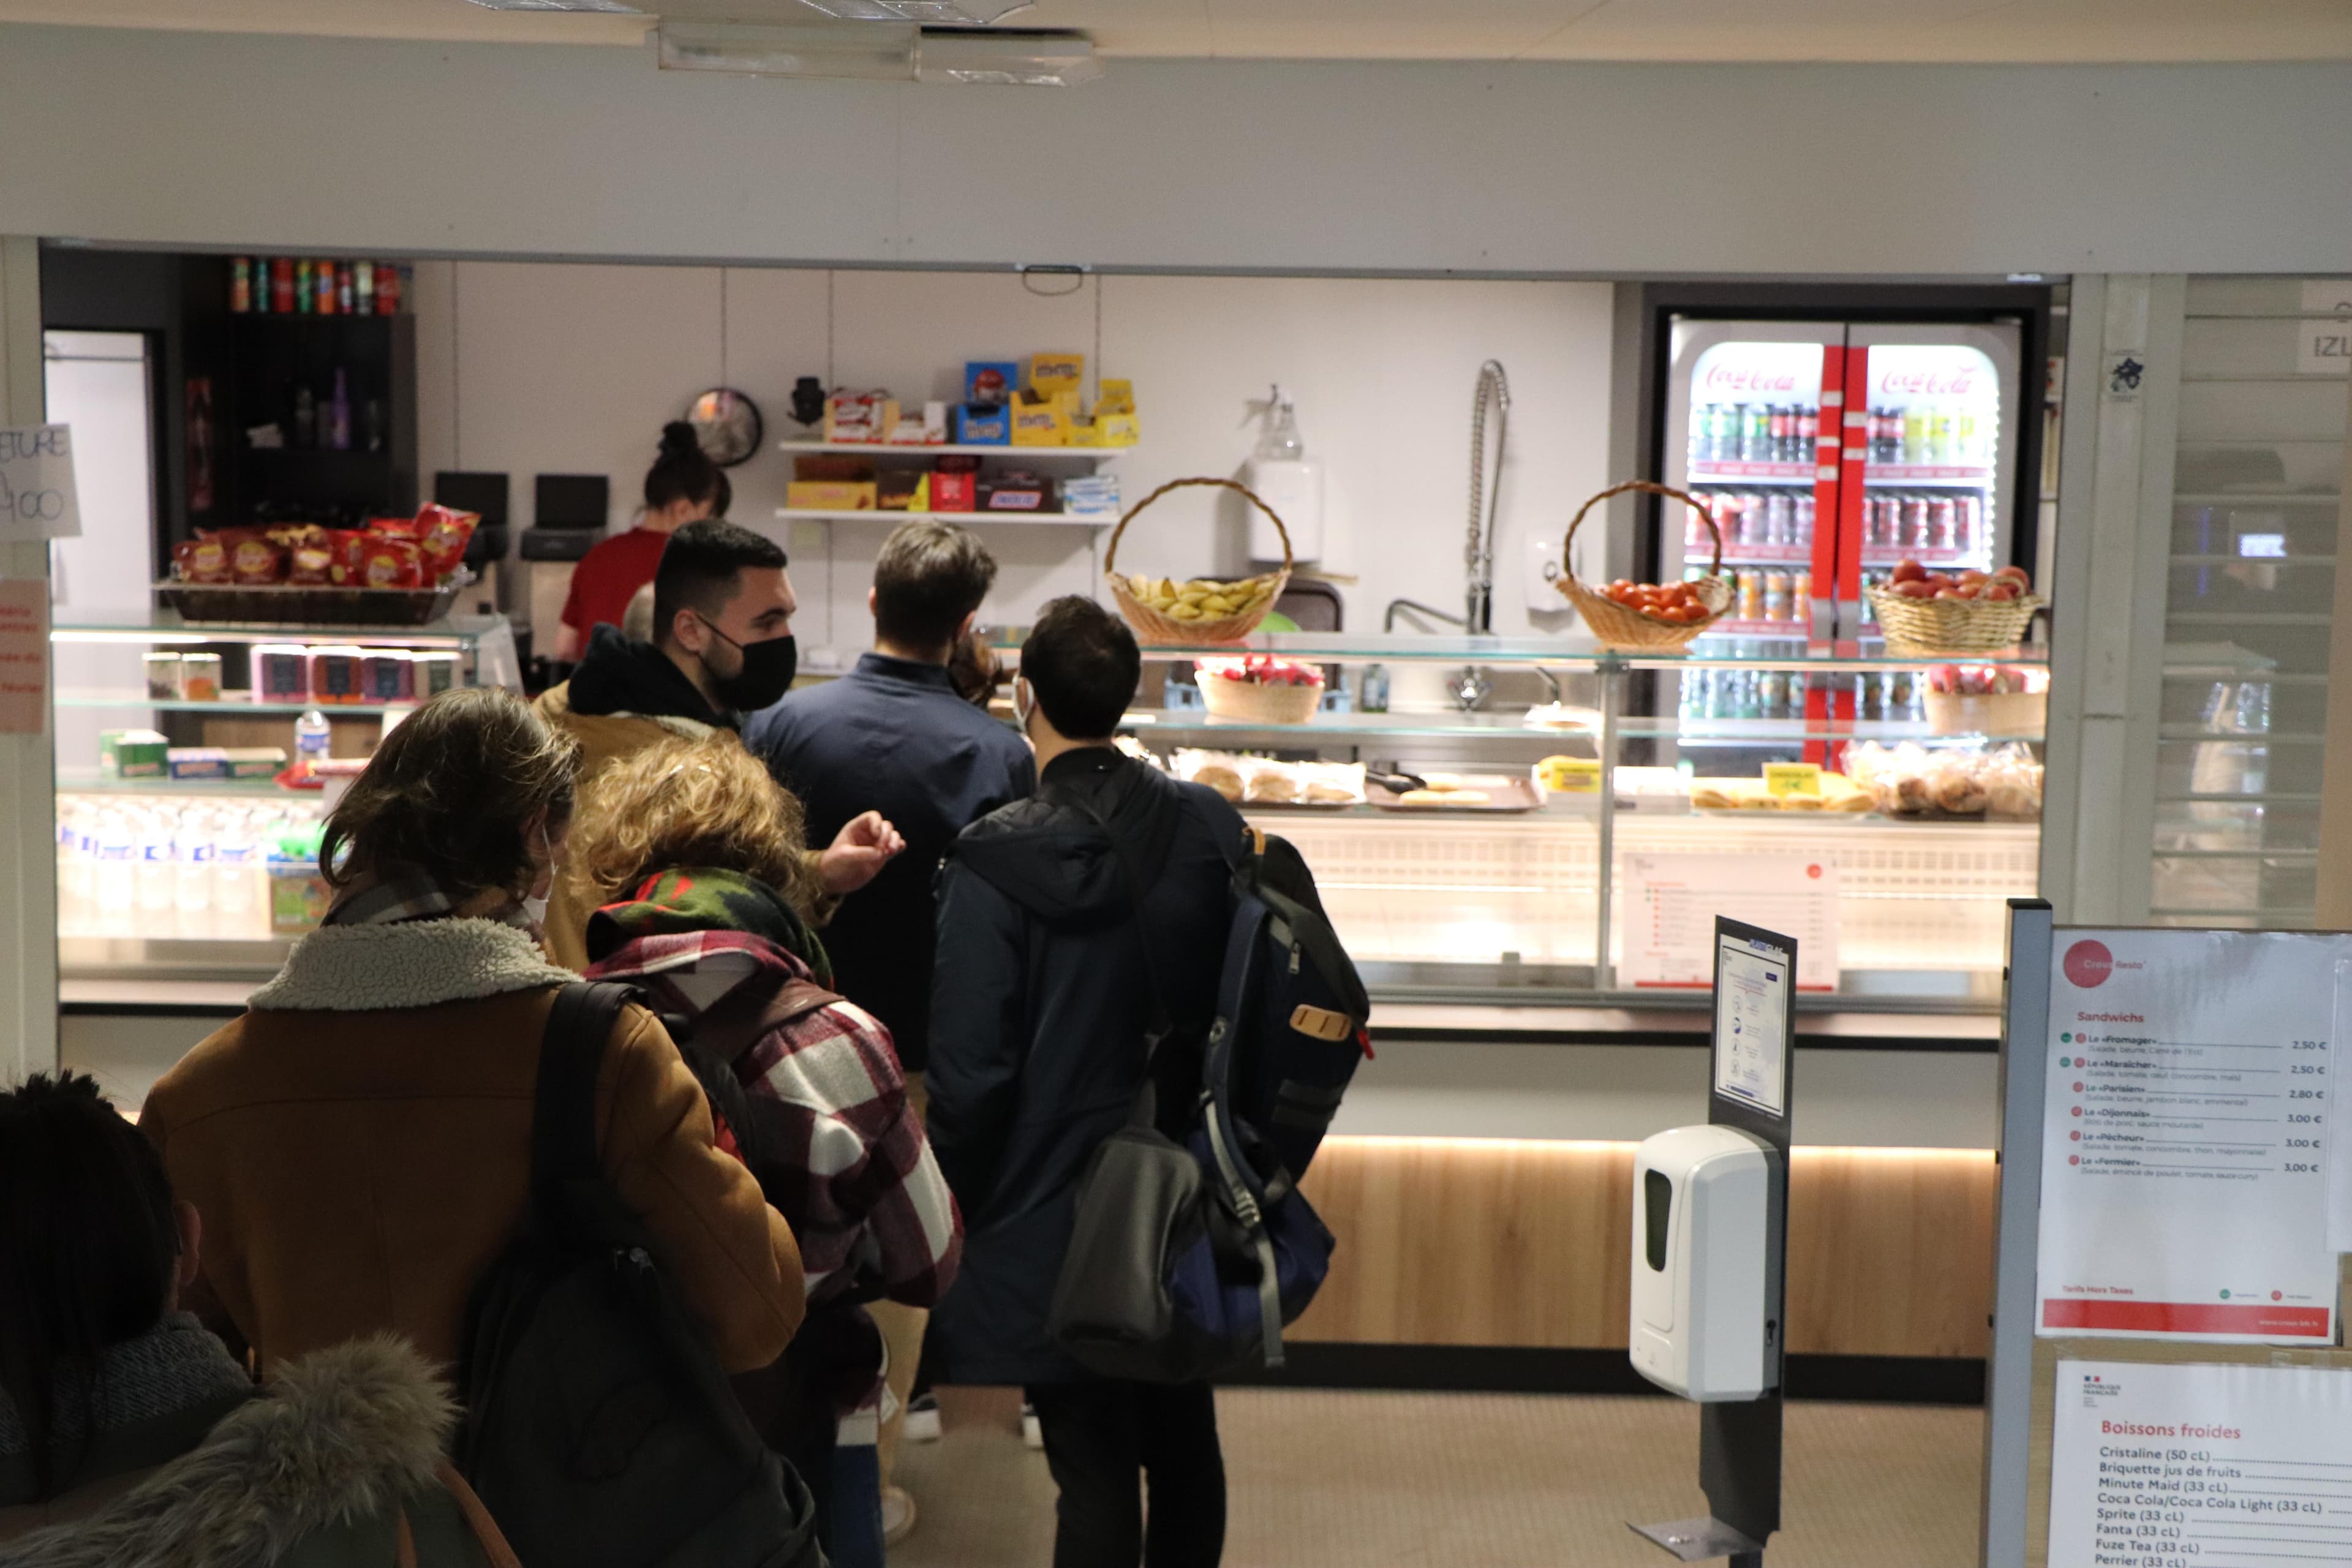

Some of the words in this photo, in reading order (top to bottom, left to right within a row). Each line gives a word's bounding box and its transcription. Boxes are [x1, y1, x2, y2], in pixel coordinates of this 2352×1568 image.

[2077, 1011, 2144, 1023] Sandwichs
[2318, 1041, 2327, 1050] €
[2317, 1066, 2325, 1074] €
[2315, 1090, 2324, 1099] €
[2313, 1115, 2322, 1123] €
[2312, 1139, 2320, 1148] €
[2310, 1164, 2318, 1172] €
[2101, 1420, 2175, 1436] Boissons
[2180, 1423, 2241, 1439] froides
[2100, 1446, 2162, 1459] Cristaline
[2166, 1449, 2187, 1461] (50
[2099, 1462, 2161, 1476] Briquette
[2164, 1464, 2182, 1477] jus
[2186, 1466, 2203, 1476] de
[2207, 1466, 2241, 1478] fruits
[2098, 1477, 2144, 1489] Minute
[2148, 1479, 2179, 1491] Maid
[2184, 1481, 2204, 1493] (33
[2097, 1493, 2130, 1504] Coca
[2135, 1494, 2202, 1508] Cola/Coca
[2206, 1498, 2236, 1509] Cola
[2241, 1498, 2272, 1513] Light
[2277, 1500, 2297, 1513] (33
[2097, 1507, 2136, 1521] Sprite
[2139, 1510, 2161, 1522] (33
[2096, 1523, 2132, 1535] Fanta
[2136, 1525, 2157, 1538] (33
[2095, 1539, 2125, 1550] Fuze
[2128, 1540, 2151, 1551] Tea
[2155, 1542, 2176, 1554] (33
[2095, 1554, 2138, 1566] Perrier
